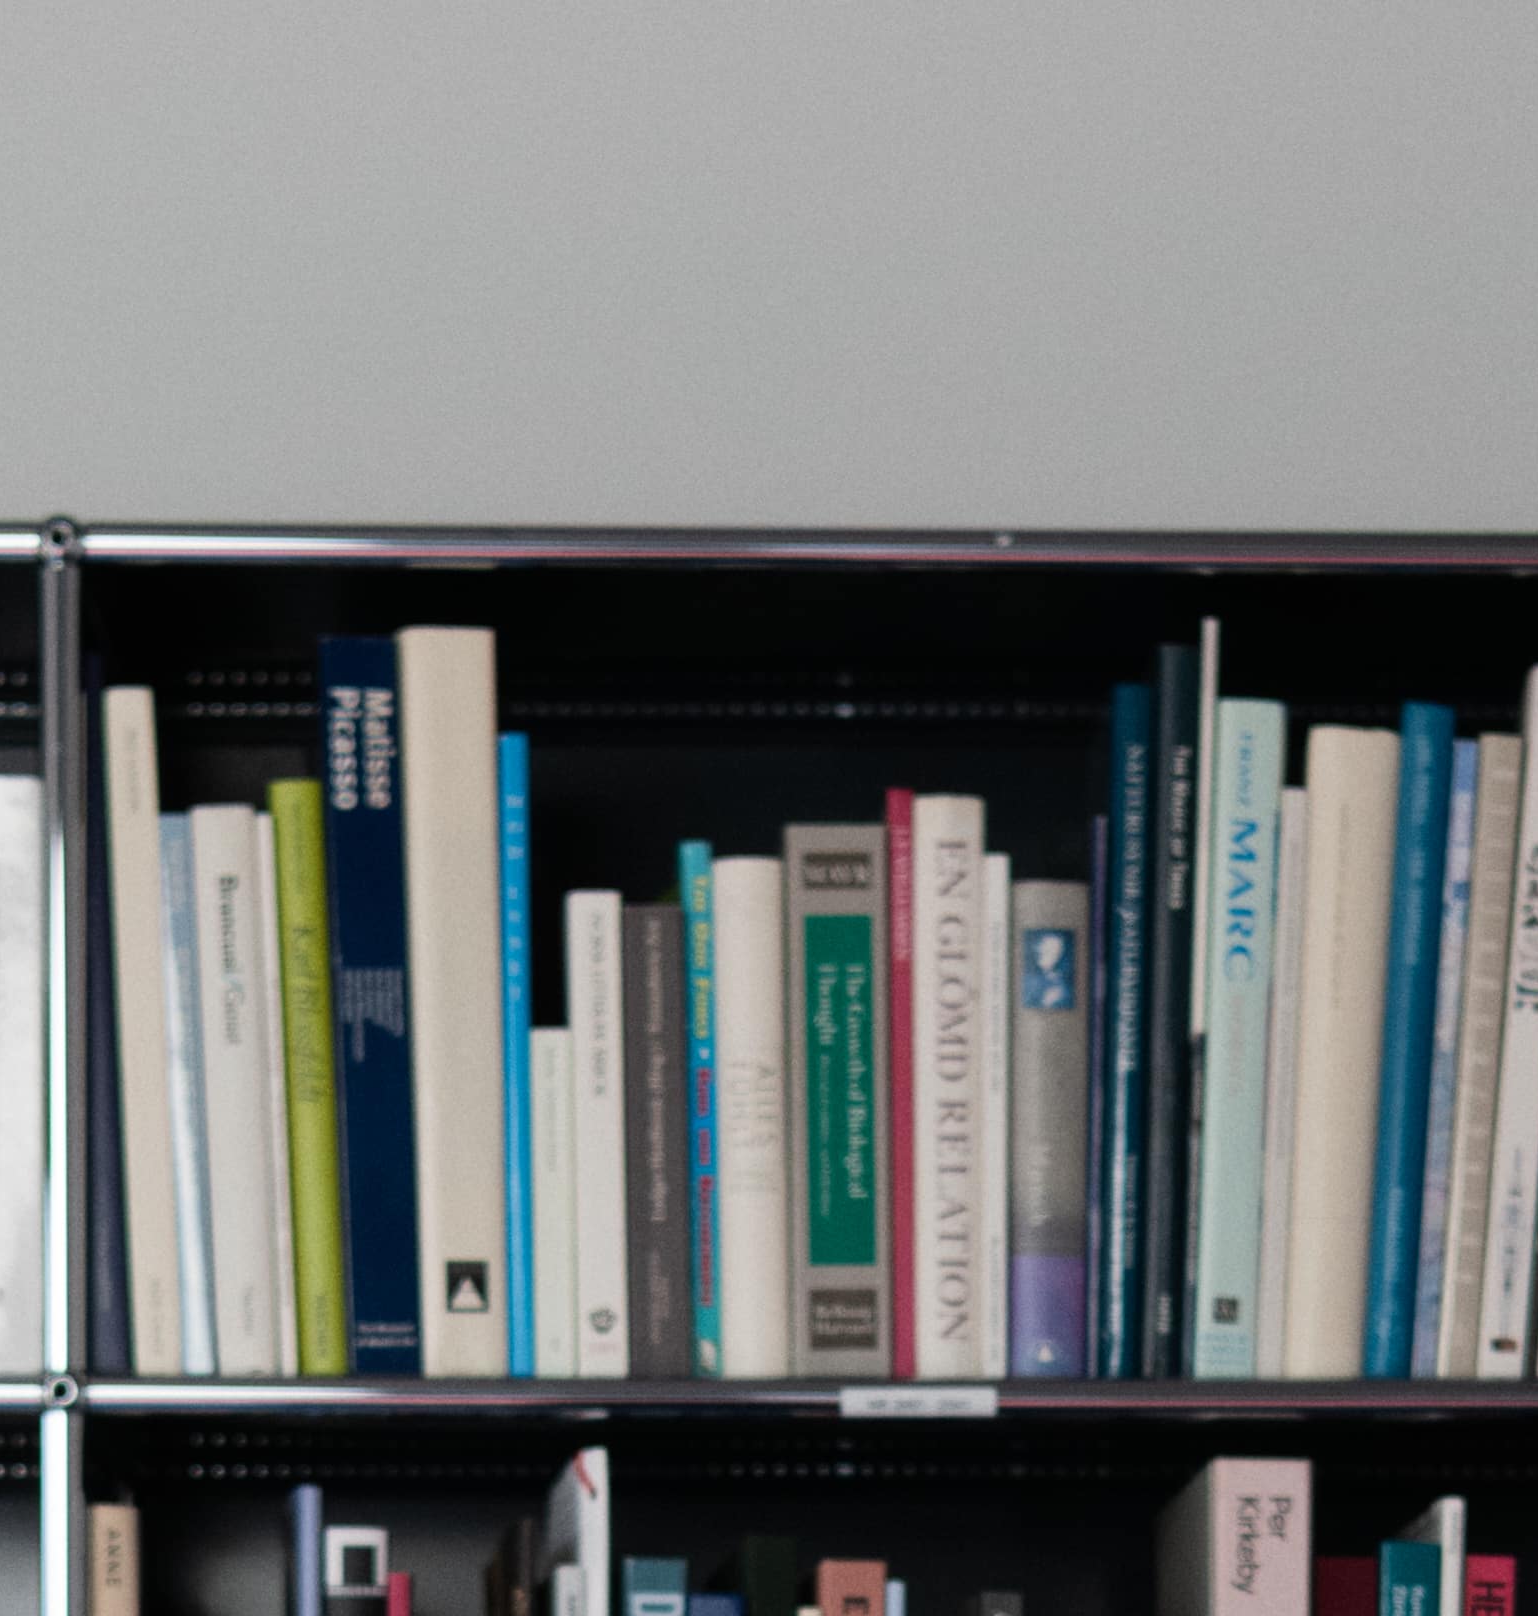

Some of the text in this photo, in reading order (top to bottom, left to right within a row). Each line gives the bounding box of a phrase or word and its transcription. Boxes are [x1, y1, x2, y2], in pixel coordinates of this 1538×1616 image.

[329, 687, 359, 810] Picasso
[362, 688, 395, 809] Matisse
[1224, 819, 1260, 982] MARC
[932, 839, 978, 1343] EN GLÖMD RELATION
[1234, 1497, 1262, 1595] Kirkeby
[1267, 1497, 1291, 1541] Per
